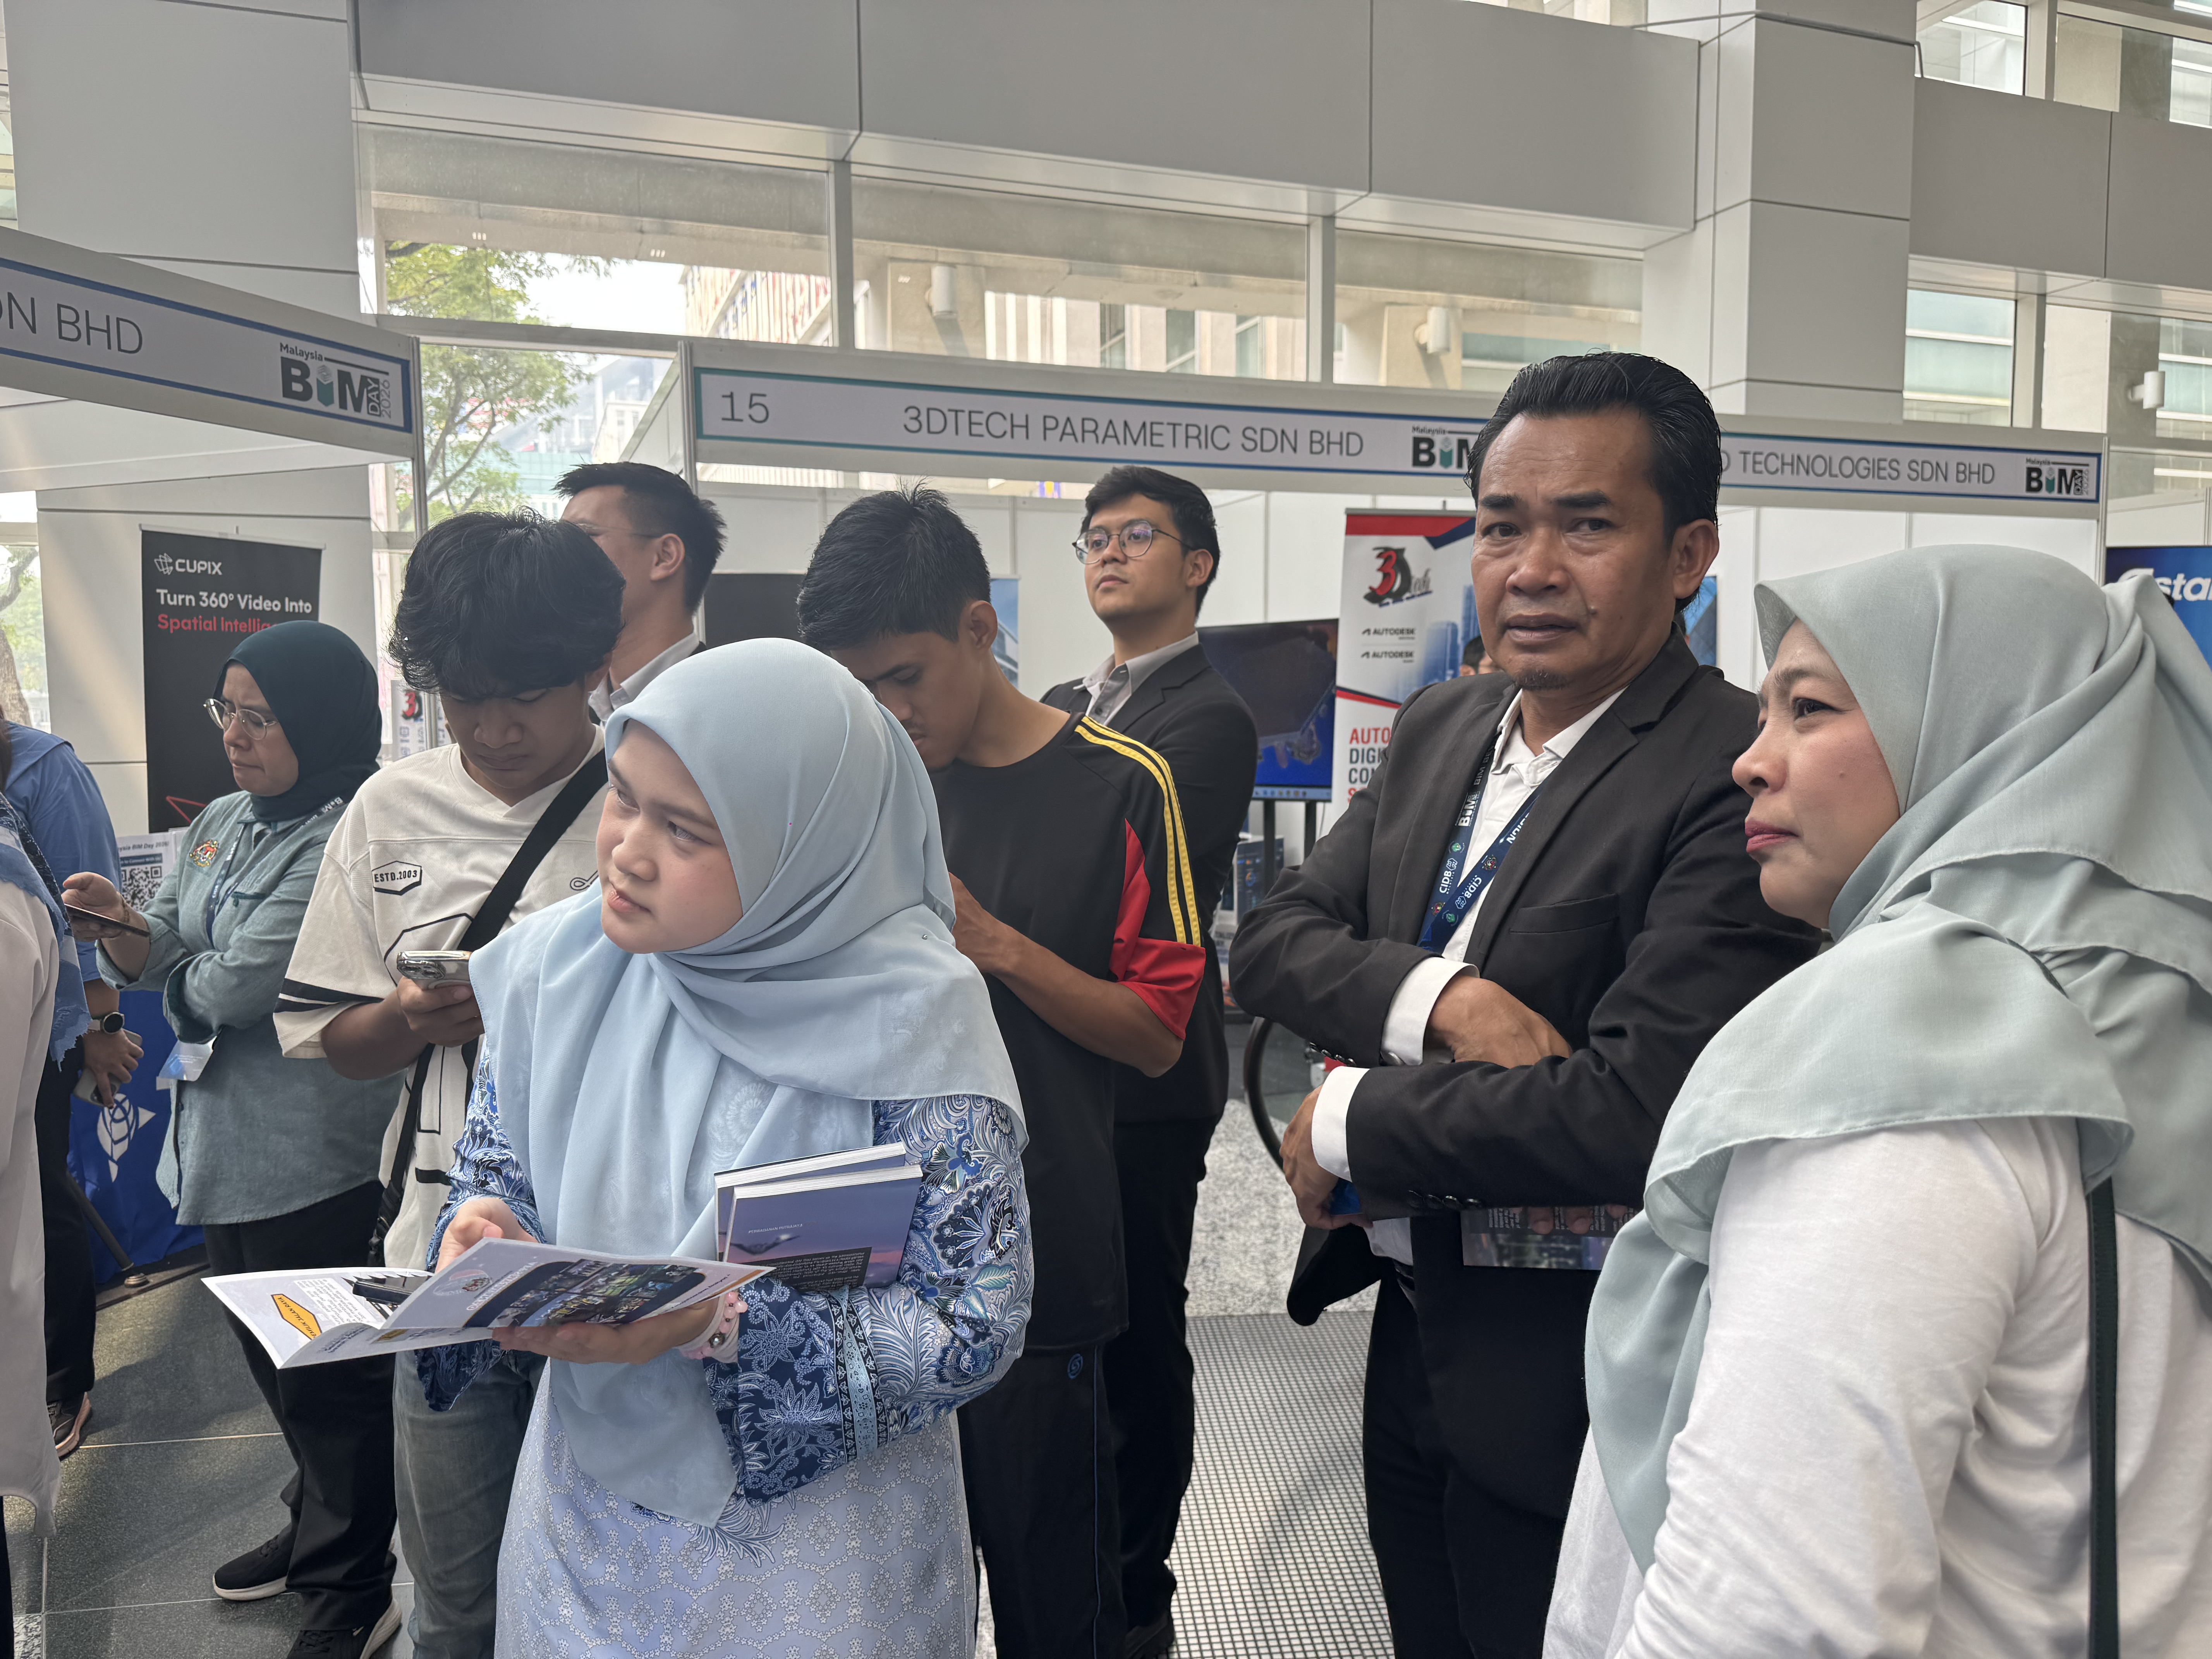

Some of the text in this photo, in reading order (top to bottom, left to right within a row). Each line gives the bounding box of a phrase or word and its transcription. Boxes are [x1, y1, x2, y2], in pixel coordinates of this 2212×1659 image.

[0, 292, 143, 354] N BHD
[280, 342, 324, 361] Malaysia
[368, 378, 381, 416] DAY
[381, 379, 392, 419] 2026
[721, 391, 1364, 457] 15 3DTECH PARAMETRIC SDN BHD
[1412, 426, 1447, 436] Malaysia
[1739, 450, 1901, 481] TECHNOLOGIES
[1907, 459, 1948, 483] SDN
[1956, 461, 1995, 484] BHD
[2025, 457, 2051, 466] Malaysia
[2074, 470, 2083, 495] DAY
[175, 559, 223, 575] CUPIX
[156, 588, 196, 607] Turn
[237, 593, 282, 612] Video
[285, 597, 313, 613] Into
[158, 614, 277, 634] Spatial Intelli
[1372, 627, 1416, 635] AUTODESK
[374, 870, 418, 883] ESTD.2003
[1439, 870, 1452, 893] CIDB
[1464, 877, 1482, 898] CIDB
[277, 1297, 290, 1310] RAYA
